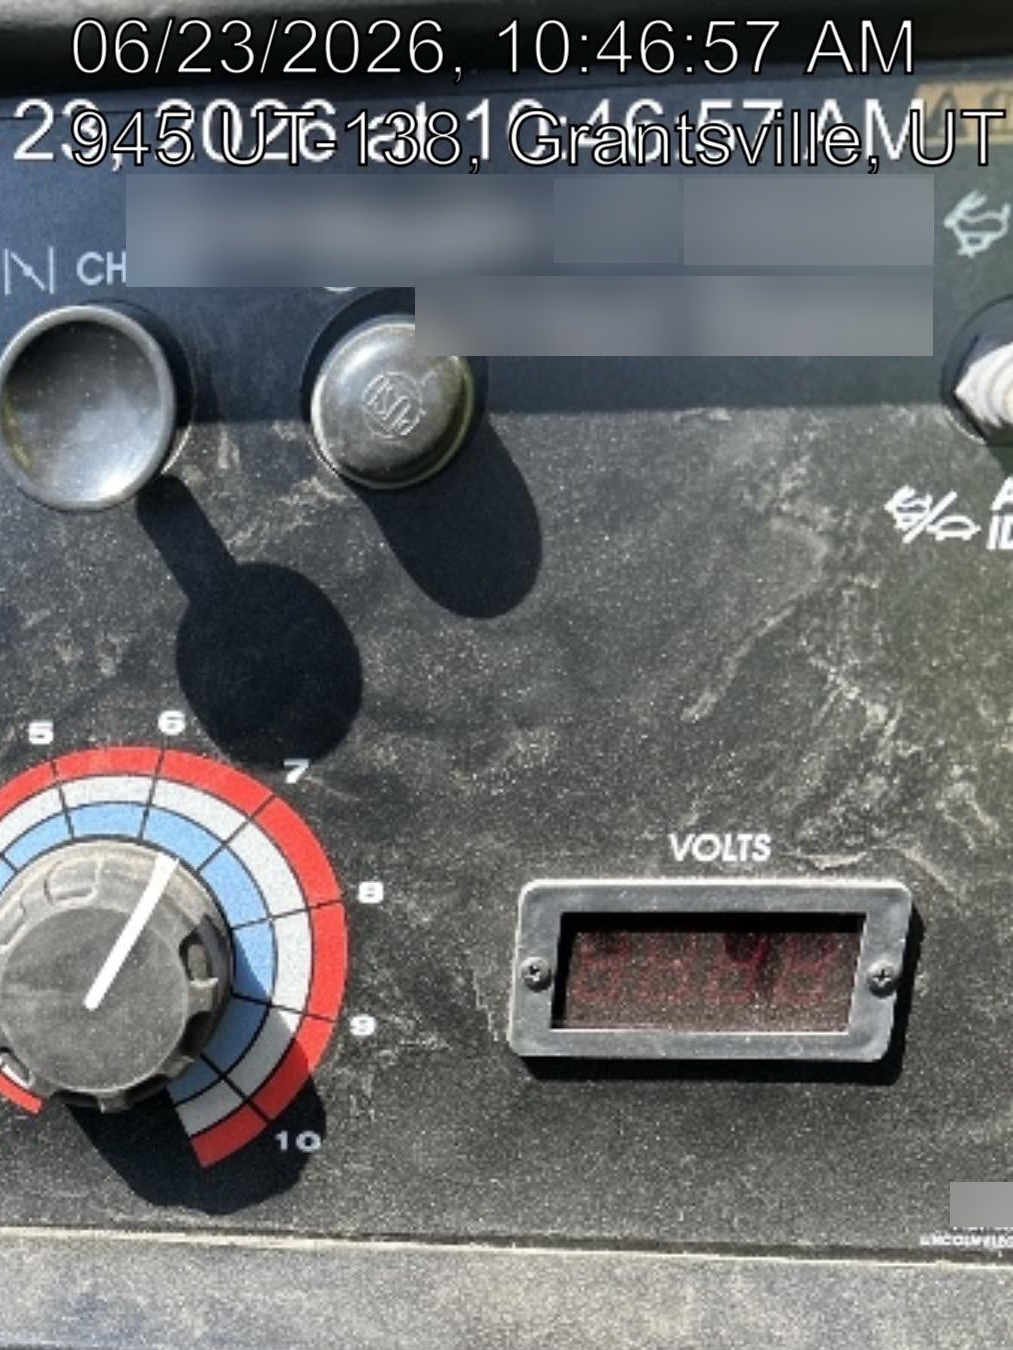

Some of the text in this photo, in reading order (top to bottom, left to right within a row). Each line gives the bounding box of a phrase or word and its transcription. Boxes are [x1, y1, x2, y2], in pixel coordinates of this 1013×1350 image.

[27, 721, 54, 747] 5
[157, 709, 185, 736] 6
[285, 759, 309, 784] 7
[669, 833, 773, 864] VOLTS
[357, 880, 384, 905] 8
[349, 1013, 376, 1037] 9
[274, 1129, 322, 1153] 10
